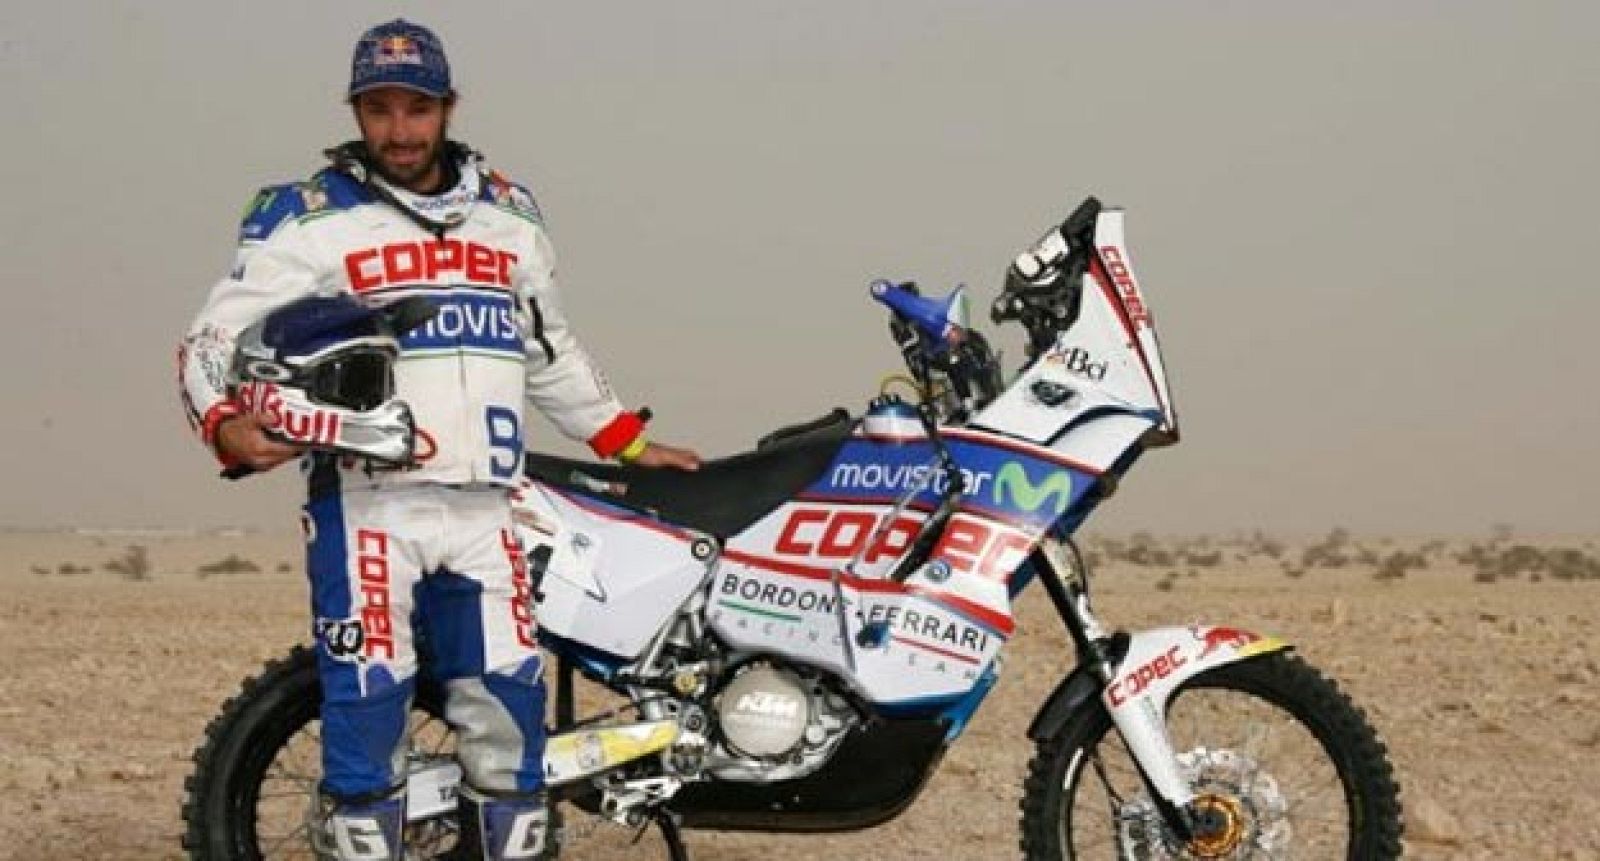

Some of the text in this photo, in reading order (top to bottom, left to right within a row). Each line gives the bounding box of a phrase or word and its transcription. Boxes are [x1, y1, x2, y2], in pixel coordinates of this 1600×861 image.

[408, 303, 516, 340] ovis
[831, 462, 992, 496] movistar
[775, 508, 1033, 580] COPEC
[357, 529, 395, 660] COPEC
